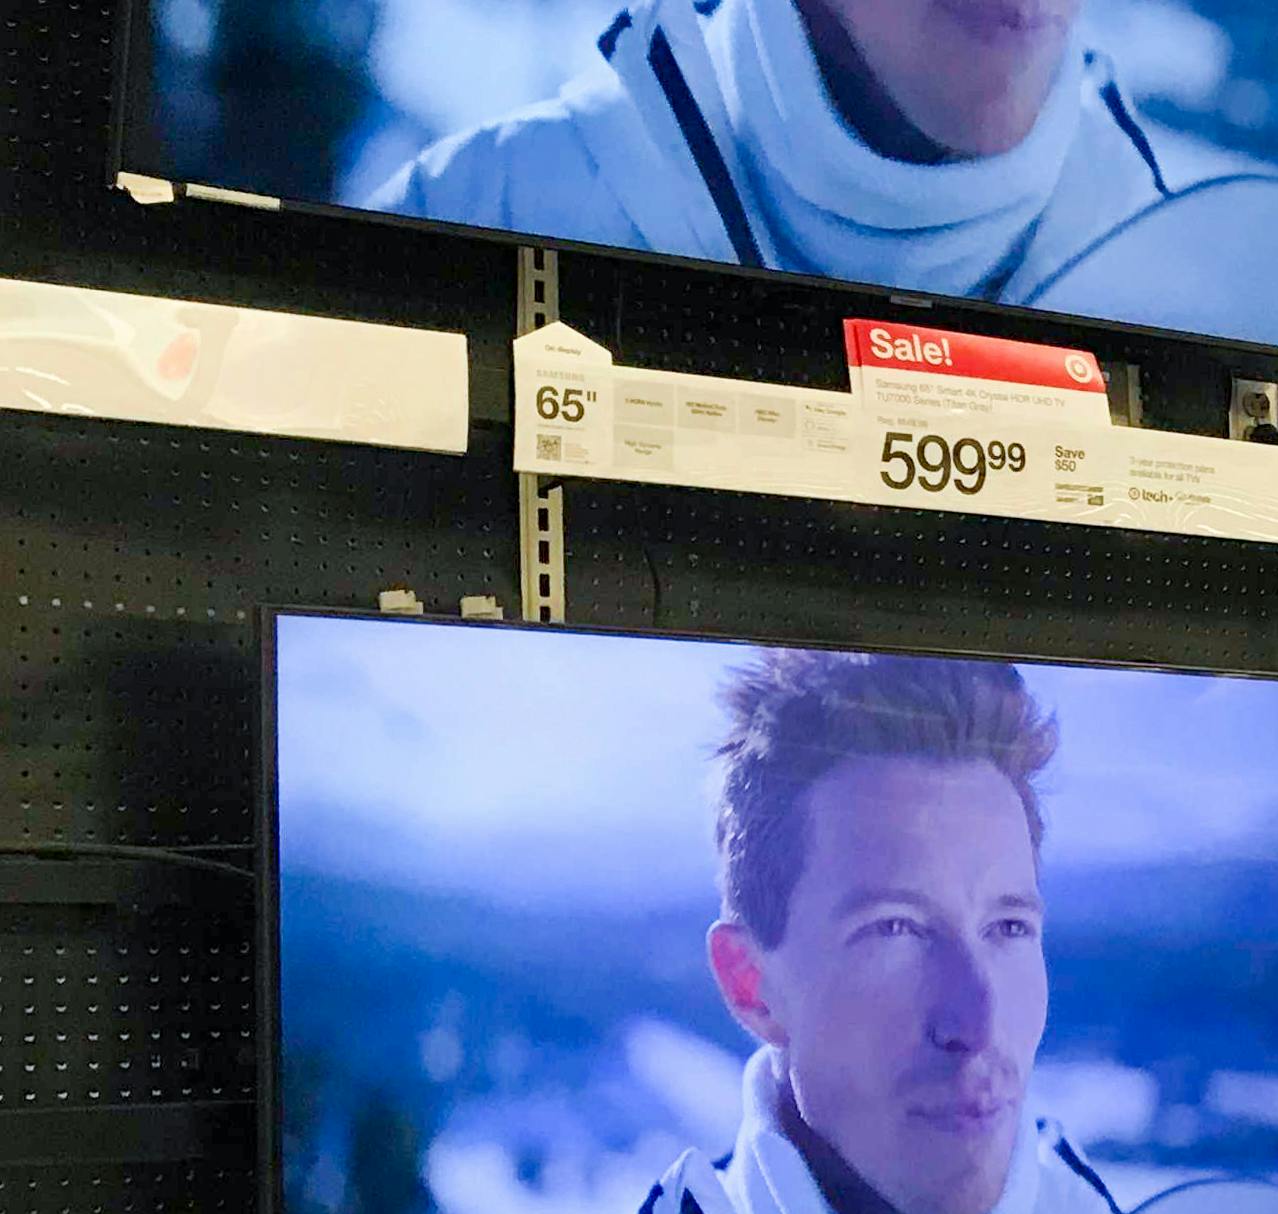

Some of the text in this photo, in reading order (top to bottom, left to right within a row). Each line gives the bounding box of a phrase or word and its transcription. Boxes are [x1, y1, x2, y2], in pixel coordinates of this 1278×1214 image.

[869, 328, 953, 366] Sale!
[536, 386, 596, 422] 65"
[1055, 445, 1085, 460] Save
